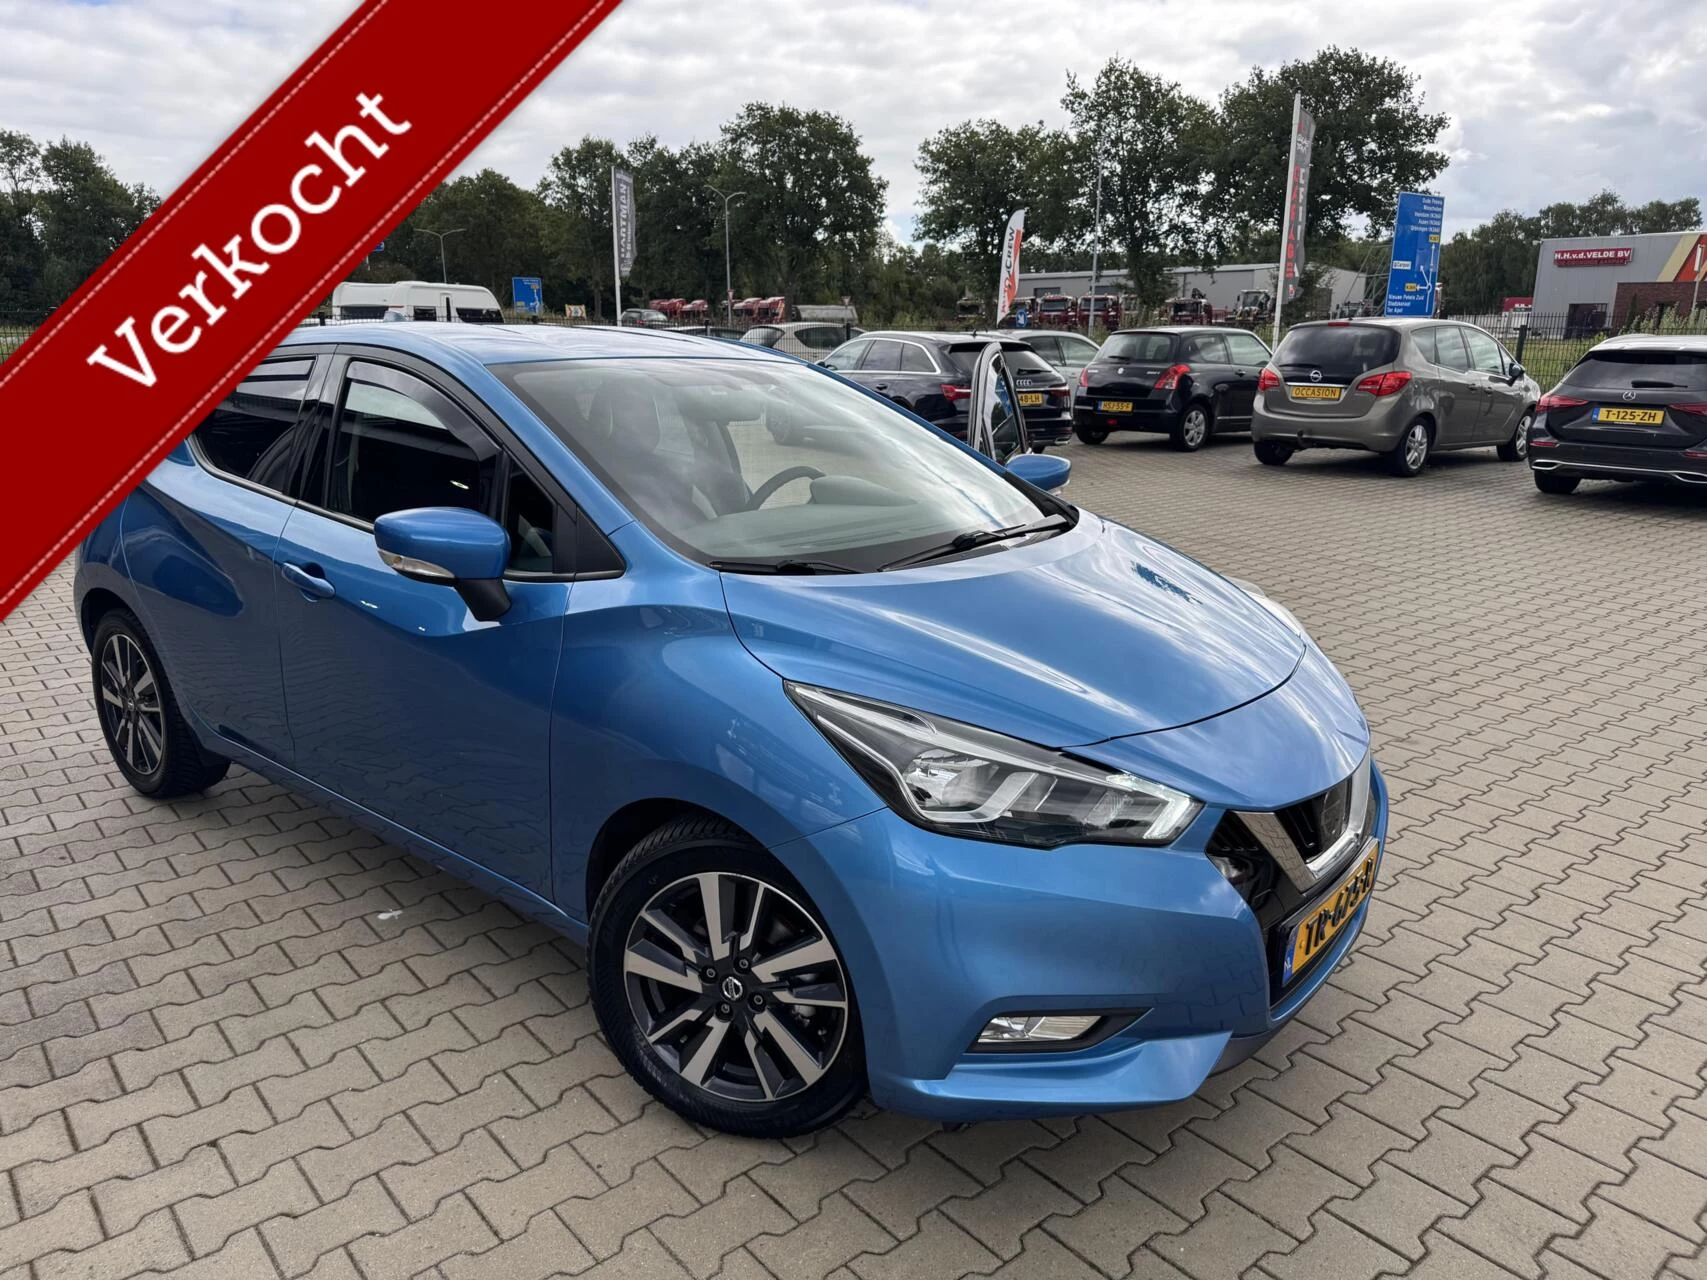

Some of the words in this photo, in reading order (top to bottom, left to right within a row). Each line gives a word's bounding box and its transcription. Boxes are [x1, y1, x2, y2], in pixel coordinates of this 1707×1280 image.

[1617, 249, 1631, 258] BV
[1294, 387, 1337, 397] OCCASION
[1019, 394, 1040, 403] 48-LH
[1605, 409, 1657, 422] T-125-ZH
